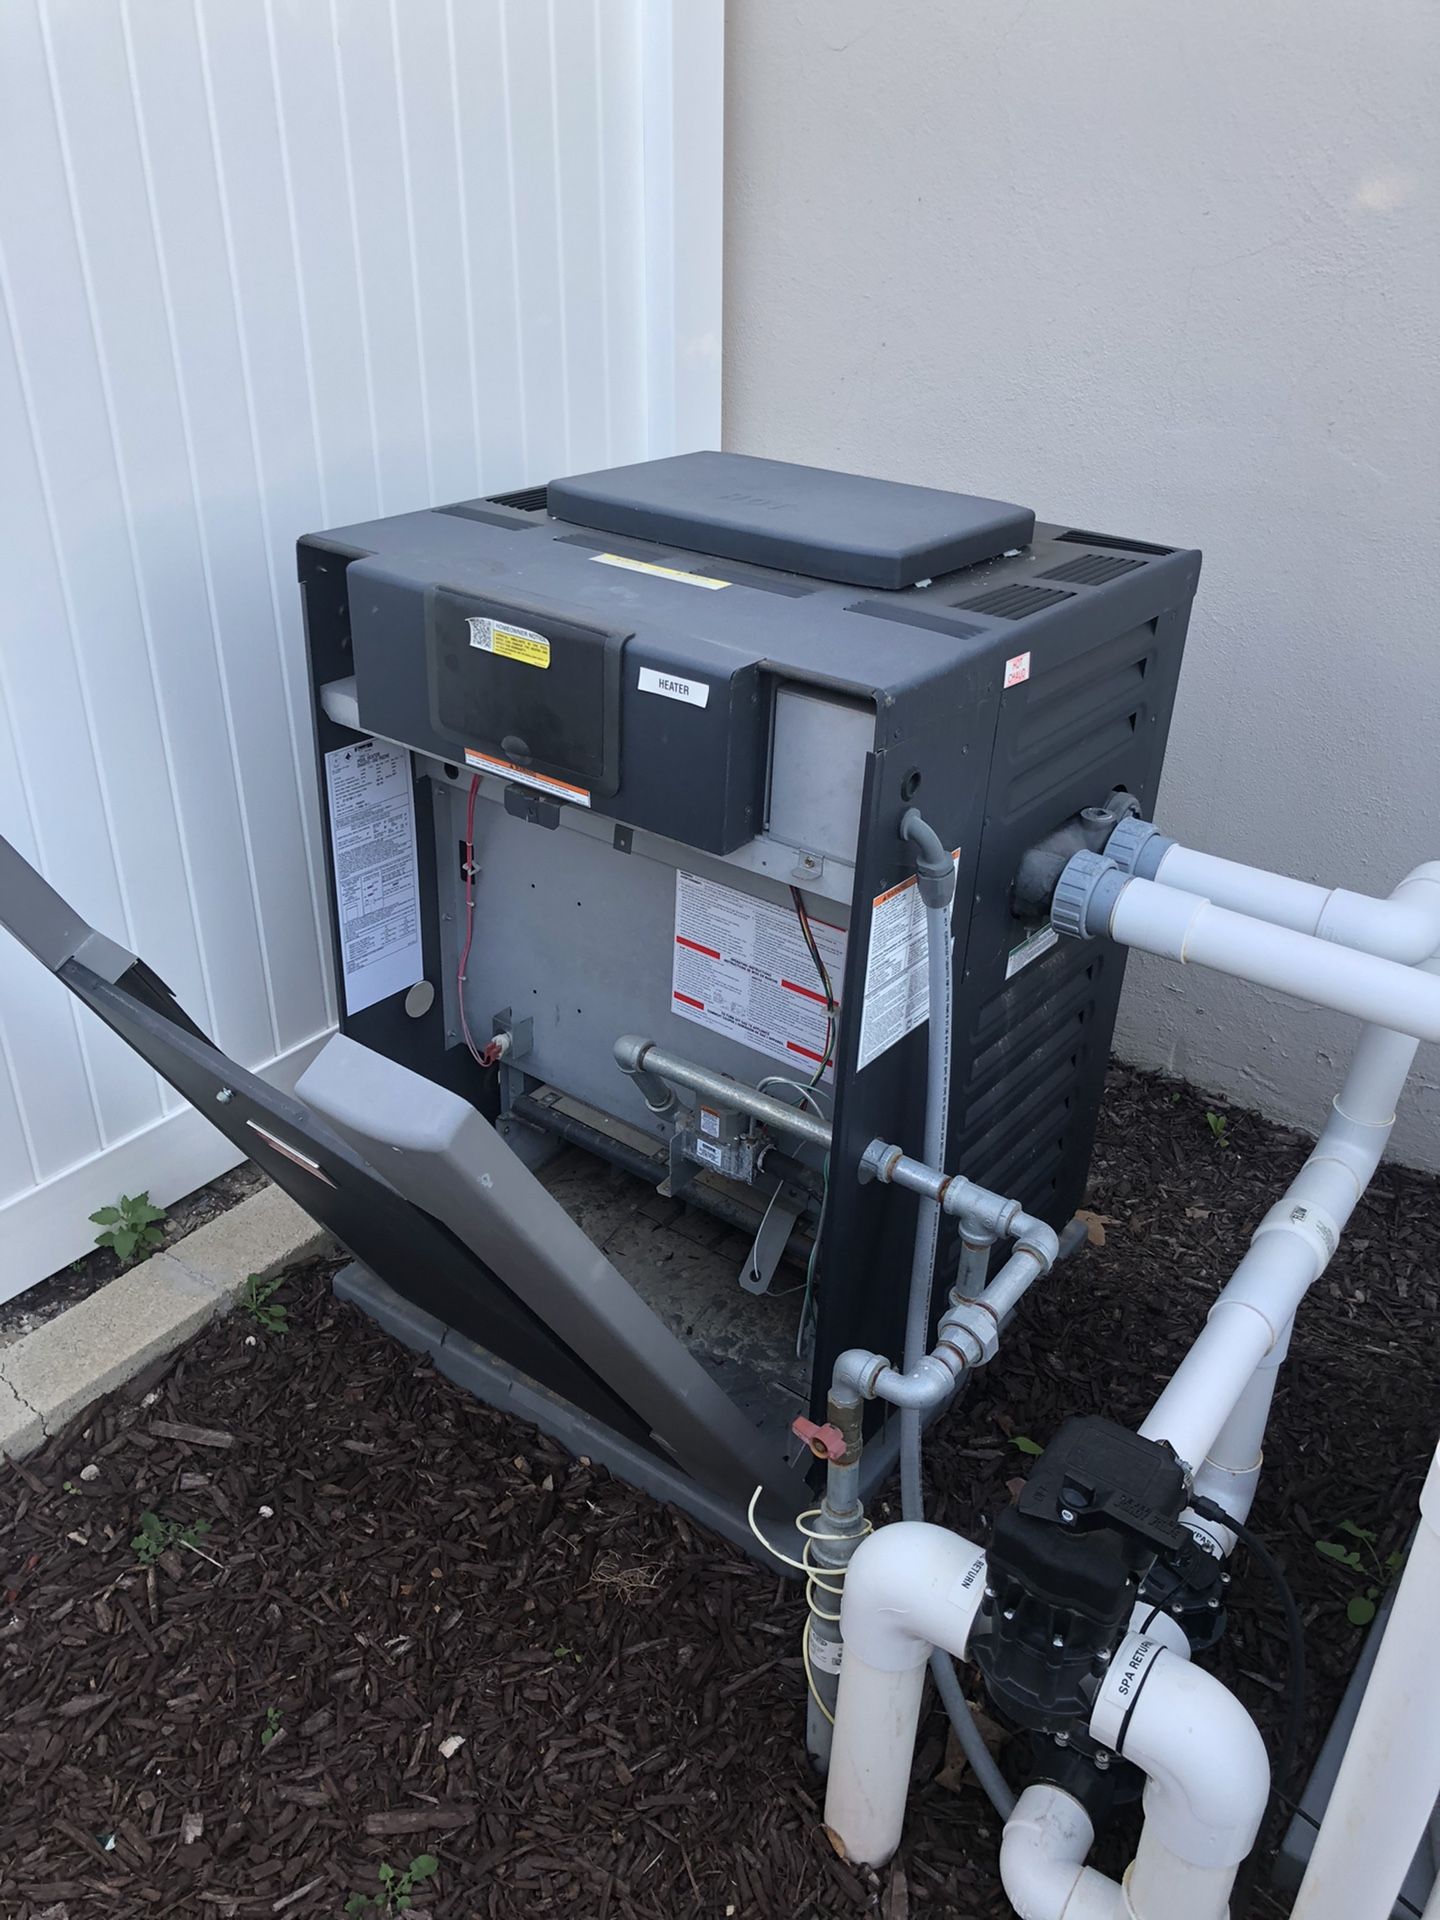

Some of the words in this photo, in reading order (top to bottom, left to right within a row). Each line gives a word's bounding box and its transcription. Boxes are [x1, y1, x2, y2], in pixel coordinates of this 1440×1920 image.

[658, 678, 689, 696] HEATER
[961, 1559, 985, 1590] RETURN
[1118, 1672, 1136, 1696] SPA
